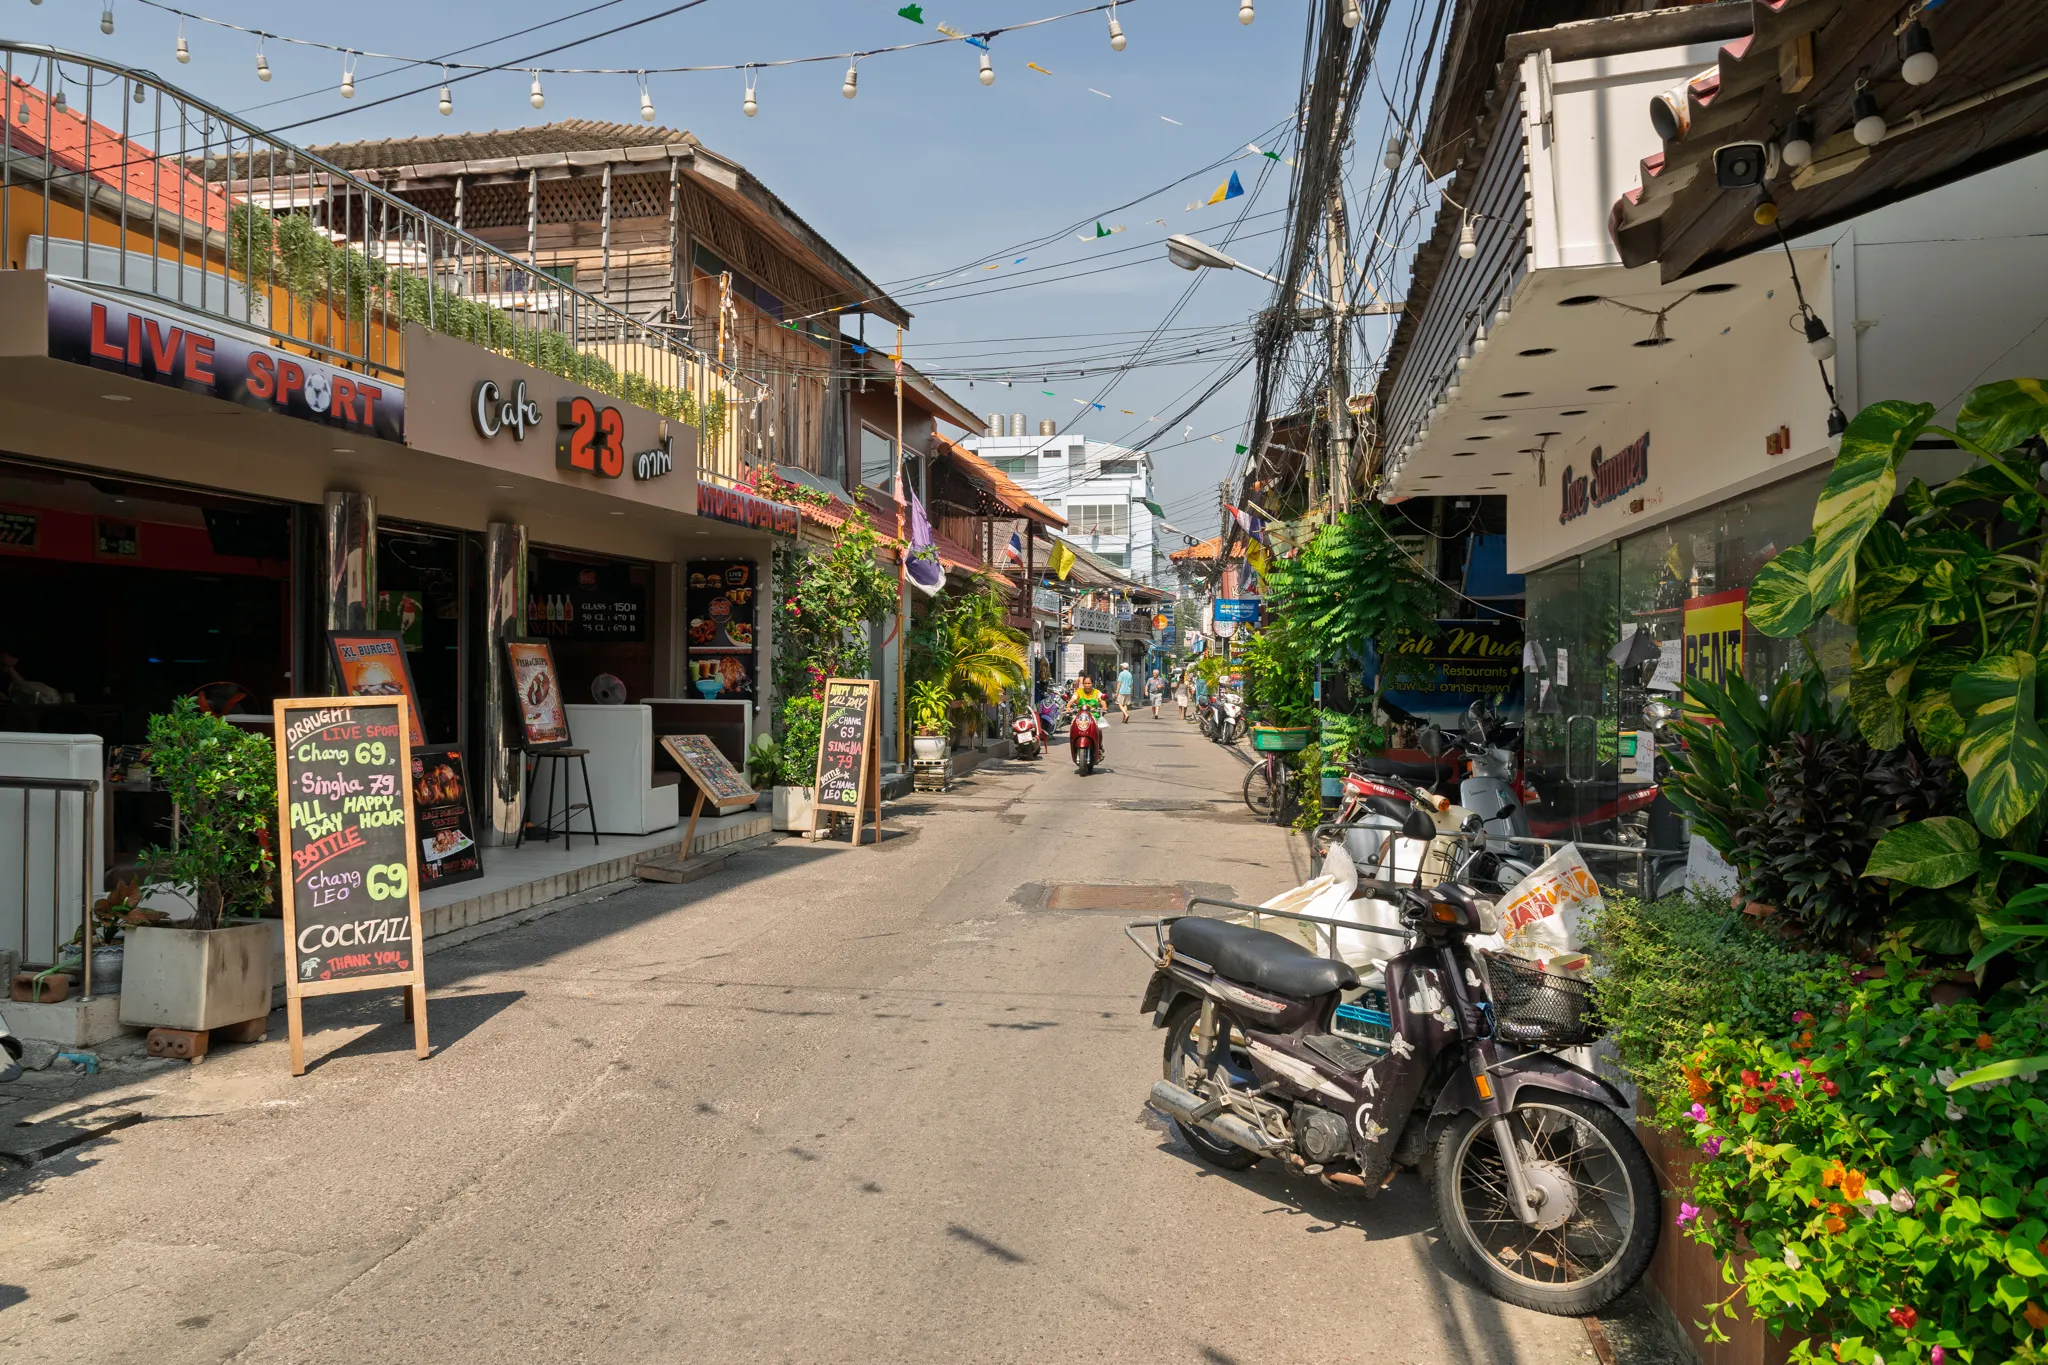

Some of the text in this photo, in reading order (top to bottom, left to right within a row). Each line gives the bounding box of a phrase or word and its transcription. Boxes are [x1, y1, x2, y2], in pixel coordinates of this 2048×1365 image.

[90, 302, 216, 387] LIVE
[471, 379, 624, 480] Cafe 23
[1589, 430, 1650, 508] Summer
[697, 482, 797, 535] KITCHEN OPEN LATE
[581, 602, 607, 611] GLASS
[582, 624, 593, 632] 75
[594, 624, 606, 632] CL
[613, 624, 627, 632] 670
[341, 641, 395, 658] XL BURGER
[1685, 629, 1741, 689] RENT
[1442, 663, 1508, 677] Restaurants
[829, 684, 869, 697] HAPPY HOUR
[829, 695, 867, 711] ALL DAY
[286, 708, 352, 744] DRAUGHT
[838, 716, 862, 726] CHANG
[322, 725, 362, 742] LIVE
[366, 724, 399, 738] SPORT
[840, 726, 855, 738] 69
[298, 741, 387, 766] Chang 69
[827, 740, 863, 755] SINGHA
[836, 755, 854, 769] 79
[301, 771, 395, 801] Singha 79
[820, 767, 841, 785] BOTTLE
[823, 789, 857, 803] LEO 69
[1373, 783, 1396, 797] YAMAHA
[290, 799, 343, 840] ALL DAY
[343, 795, 405, 829] HAPPY HOUR
[293, 825, 362, 870] BOTTLE
[366, 863, 408, 901] 69
[313, 887, 350, 907] LEO
[297, 915, 412, 954] COCKTAIL
[326, 950, 401, 972] THANK YOU
